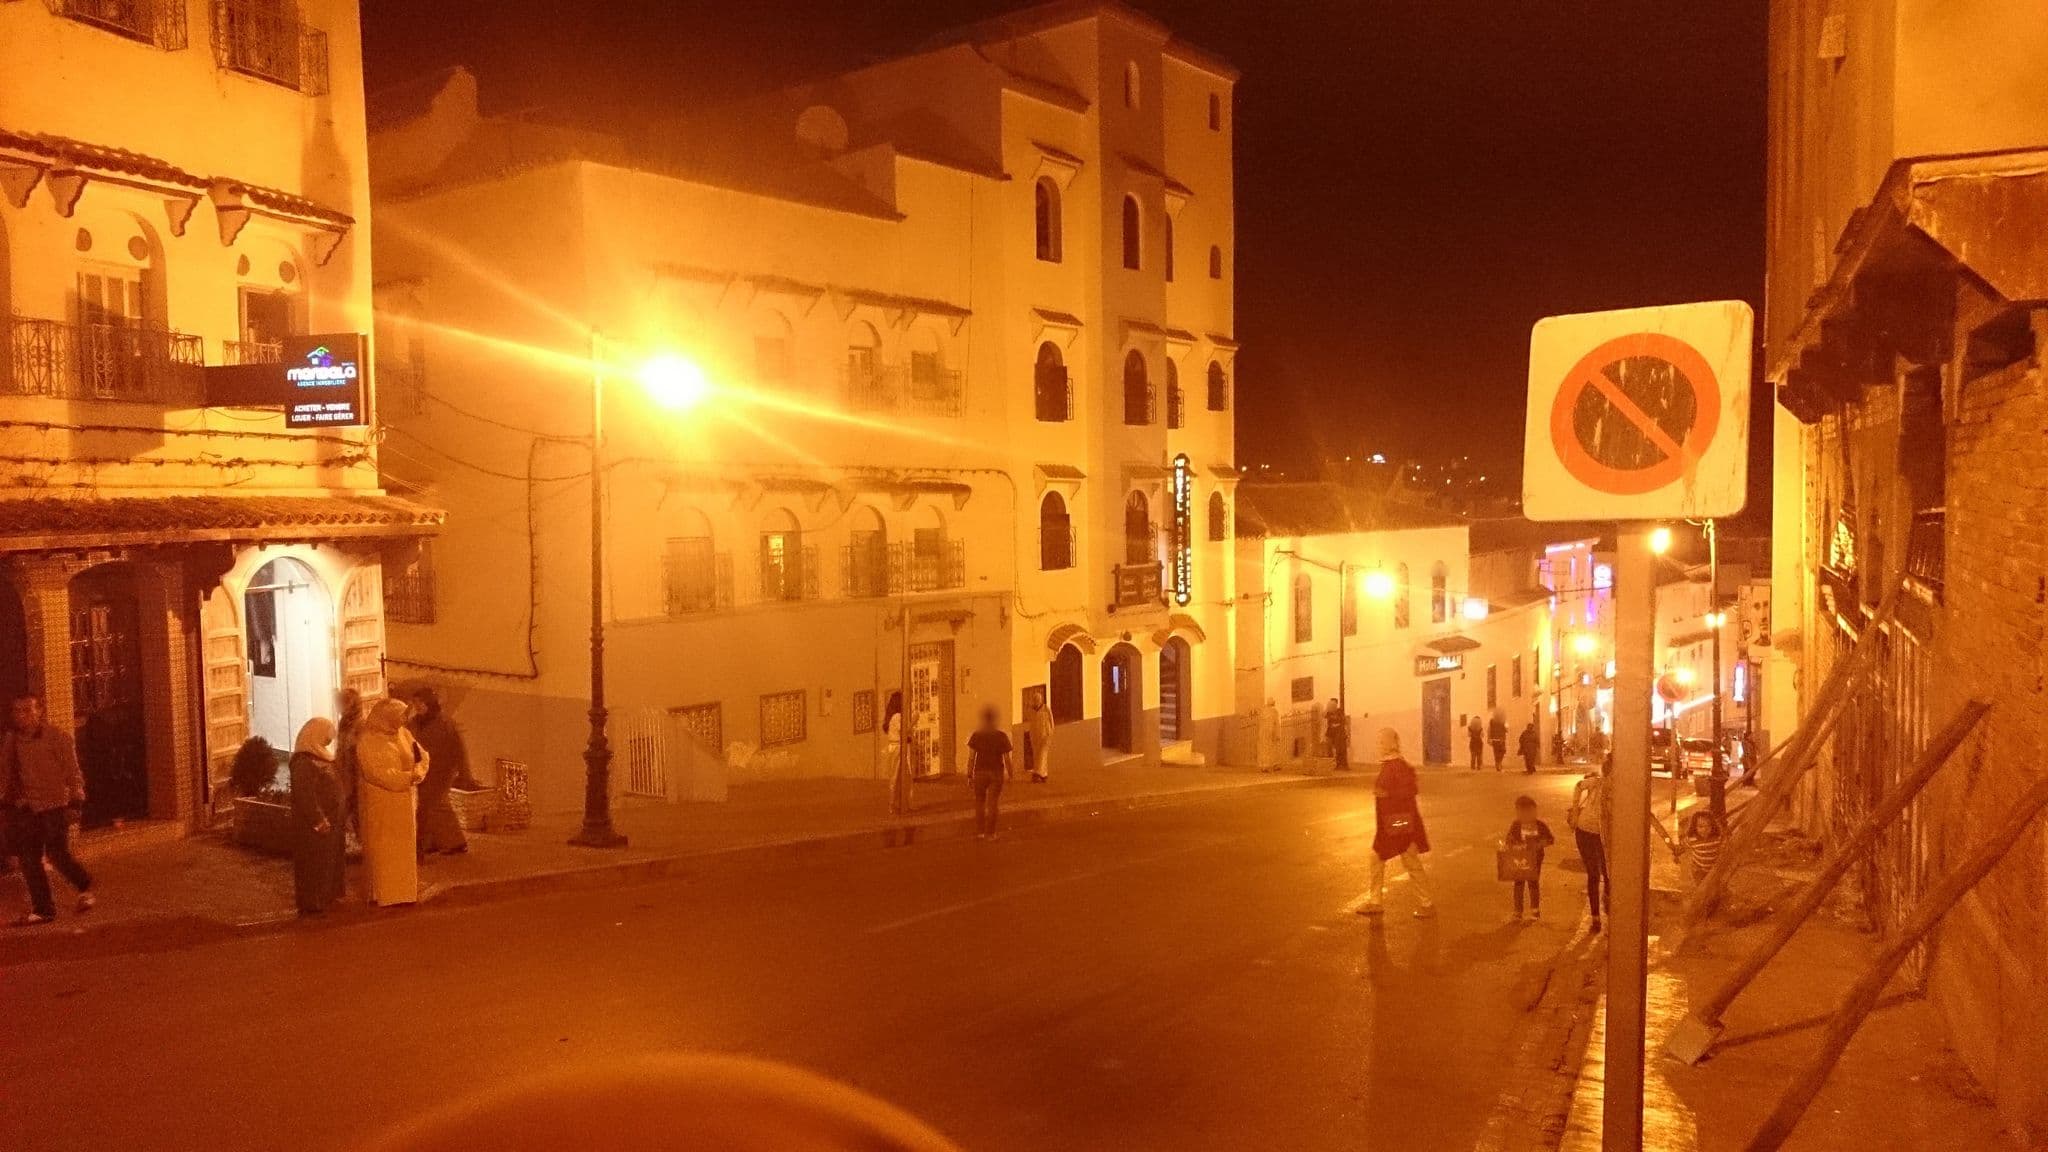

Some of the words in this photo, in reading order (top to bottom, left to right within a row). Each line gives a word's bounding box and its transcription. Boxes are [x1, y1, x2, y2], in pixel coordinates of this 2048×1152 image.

[291, 414, 311, 422] LOUER
[315, 413, 333, 421] FAIRE
[1176, 468, 1184, 511] HOTEL
